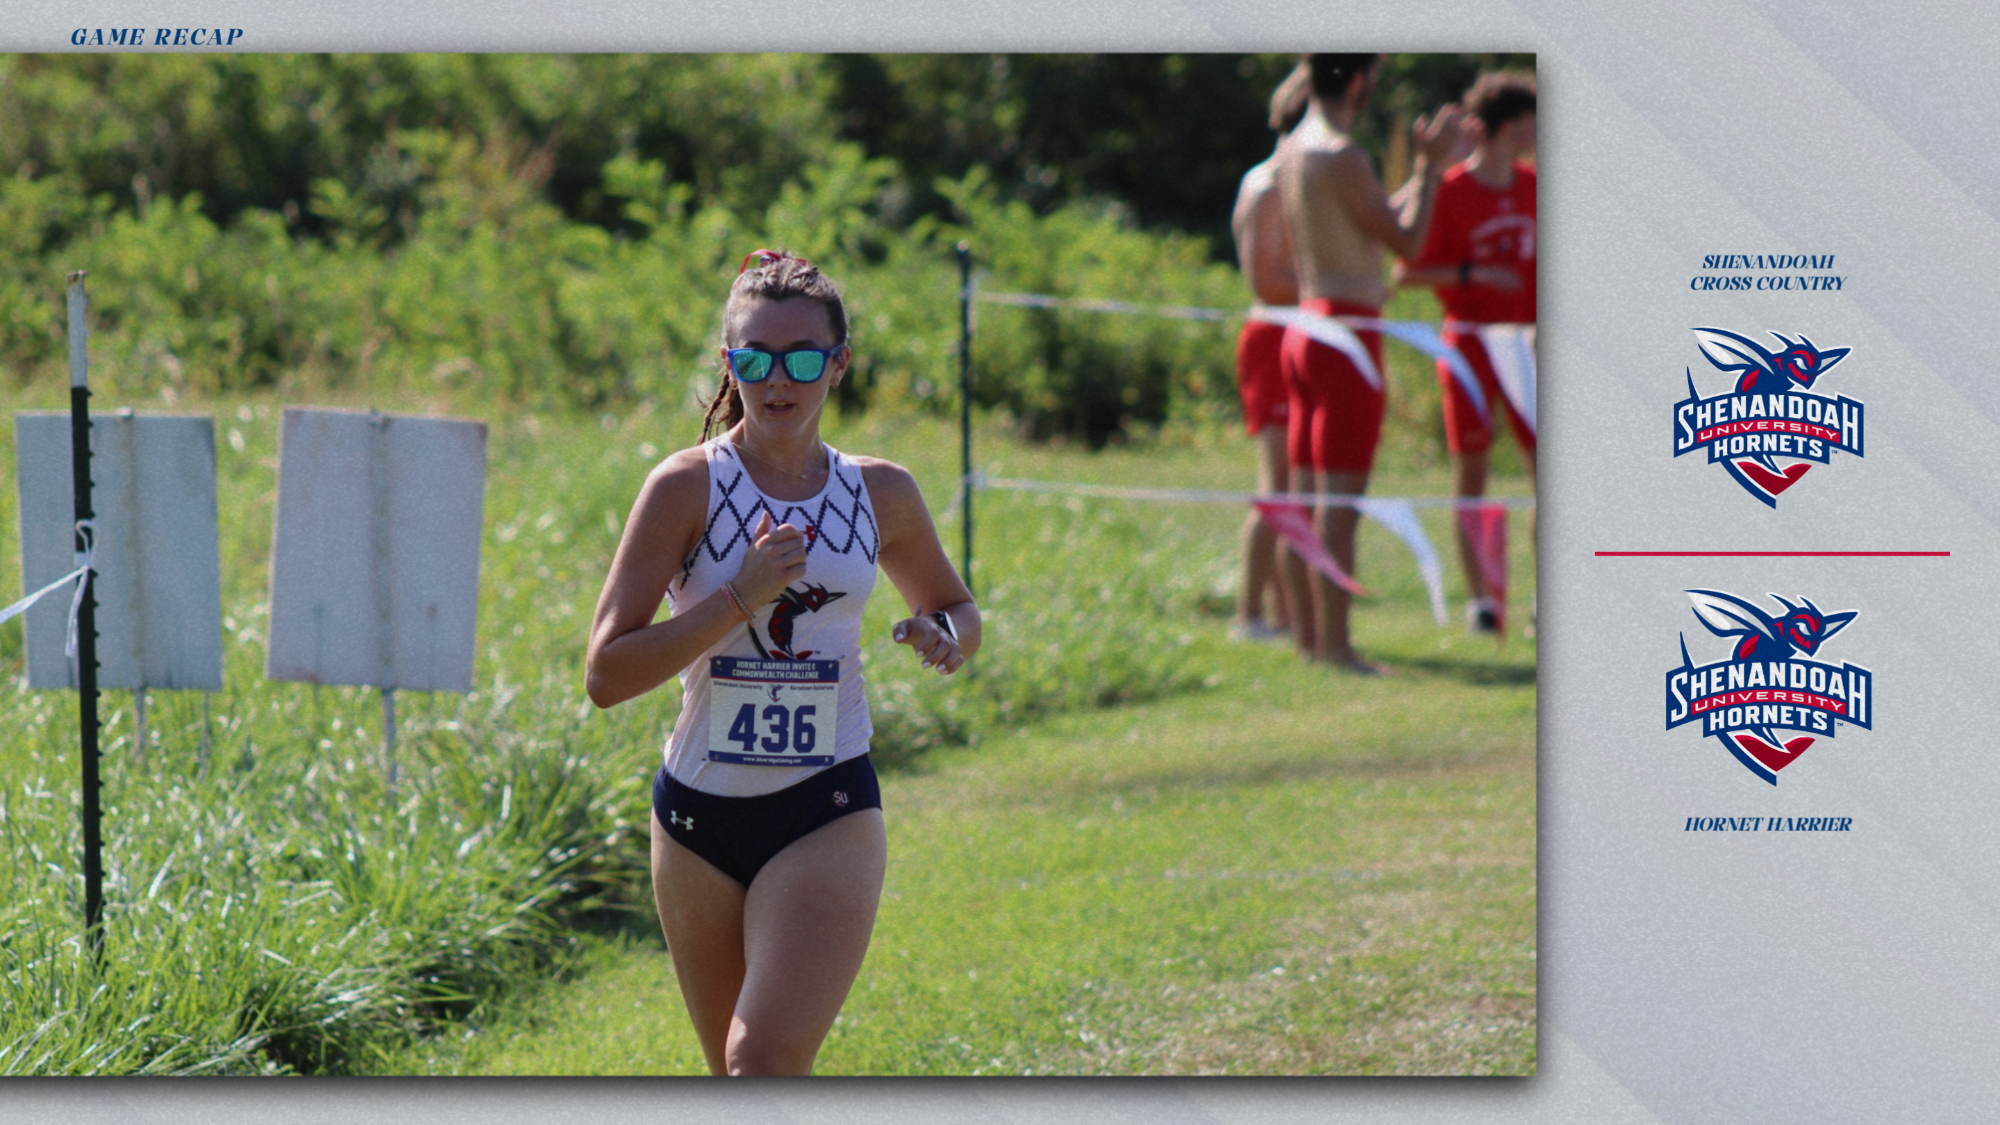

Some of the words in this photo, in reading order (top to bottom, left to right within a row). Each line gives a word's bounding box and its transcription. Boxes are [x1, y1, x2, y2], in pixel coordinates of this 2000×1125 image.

[736, 660, 761, 670] HORNET
[762, 661, 791, 671] HARRIER
[791, 662, 811, 671] INVITE
[731, 668, 785, 679] COMMONWEALTH
[785, 670, 820, 680] CHALLENGE
[727, 703, 816, 753] 436
[833, 790, 849, 804] SU
